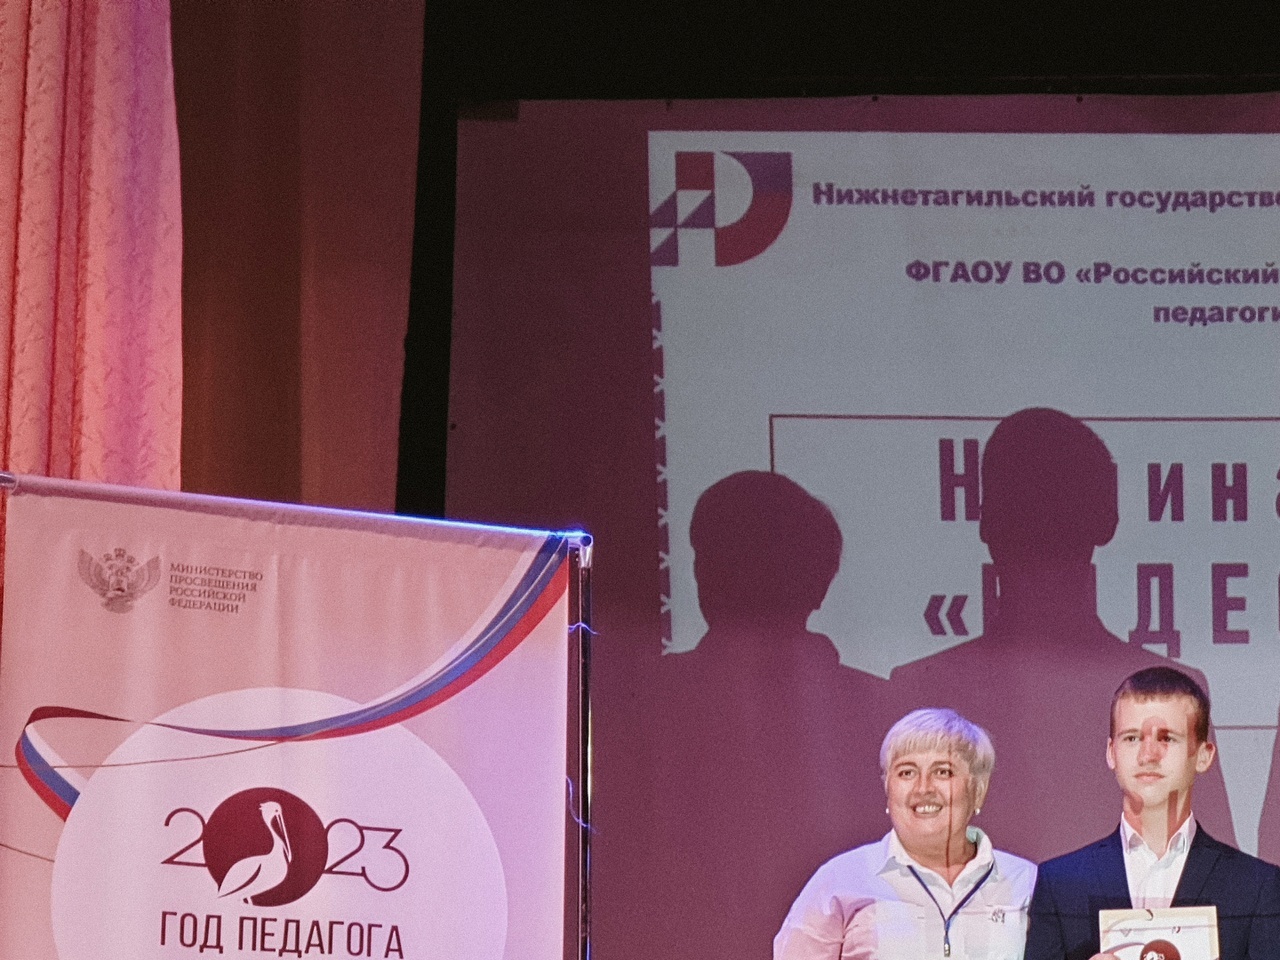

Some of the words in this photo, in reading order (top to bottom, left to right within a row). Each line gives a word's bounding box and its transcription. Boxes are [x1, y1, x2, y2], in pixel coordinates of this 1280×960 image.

[812, 182, 1095, 208] Нижнетагильский
[905, 259, 1012, 286] ФГАОУ
[1022, 261, 1066, 285] ВО
[1075, 259, 1280, 286] «Российский
[169, 563, 264, 582] МИНИСТЕРСТВО
[168, 574, 258, 592] ПРОСВЕЩЕНИЯ
[168, 586, 247, 603] РОССИЙСКОЙ
[168, 598, 240, 614] ФЕДЕРАЦИИ
[160, 910, 224, 954] ГОД
[237, 915, 405, 960] ПЕДАГОГА
